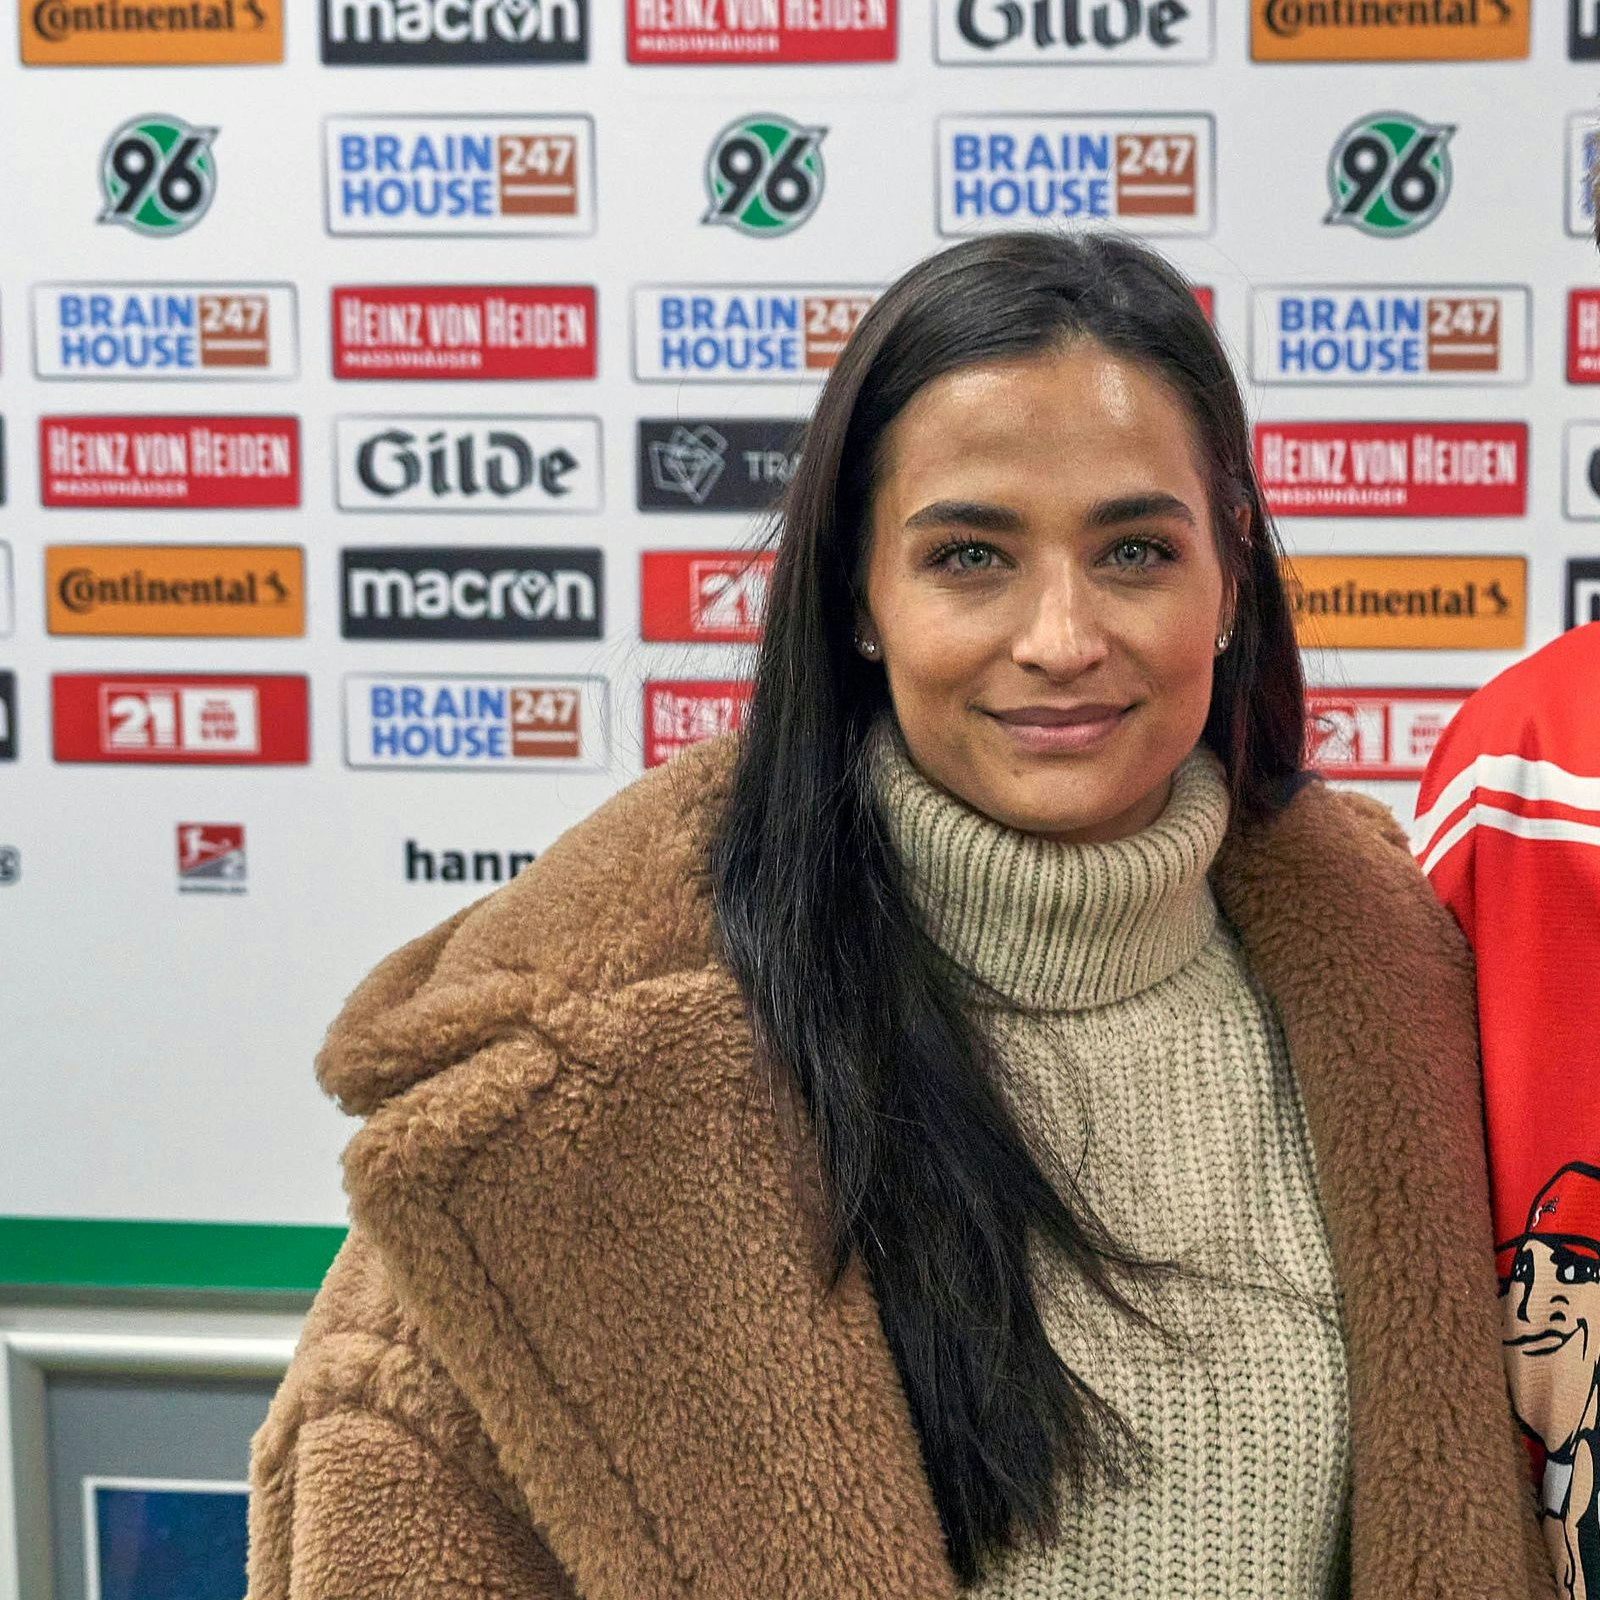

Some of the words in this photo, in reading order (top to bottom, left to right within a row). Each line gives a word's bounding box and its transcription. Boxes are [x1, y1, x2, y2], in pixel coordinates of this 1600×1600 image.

[723, 0, 779, 31] VON
[340, 134, 493, 173] BRAIN
[501, 139, 573, 176] 247
[952, 134, 1110, 173] BRAIN
[1119, 139, 1191, 176] 247
[1342, 135, 1438, 214] 96
[111, 137, 204, 214] 96
[716, 137, 812, 214] 96
[341, 180, 493, 217] HOUSE
[952, 180, 1110, 217] HOUSE
[59, 294, 194, 329] BRAIN
[204, 299, 265, 332] 247
[340, 297, 422, 347] HEINZ
[426, 304, 482, 347] VON
[485, 297, 587, 347] HEIDEN
[660, 295, 797, 330] BRAIN
[1279, 298, 1420, 332] BRAIN
[1429, 302, 1495, 335] 247
[60, 334, 194, 369] HOUSE
[661, 336, 797, 370] HOUSE
[1279, 339, 1420, 372] HOUSE
[50, 427, 129, 476] HEINZ
[132, 433, 188, 476] VON
[190, 428, 290, 477] HEIDEN
[357, 428, 579, 498] Gilde
[1262, 434, 1346, 484] HEINZ
[1351, 440, 1407, 484] VON
[1412, 434, 1517, 485] HEIDEN
[59, 568, 257, 614] Continental
[349, 568, 594, 620] macron
[1296, 580, 1476, 616] ntinental
[111, 694, 176, 747] 21
[370, 686, 504, 718] BRAIN
[513, 692, 575, 724] 247
[371, 726, 504, 758] HOUSE
